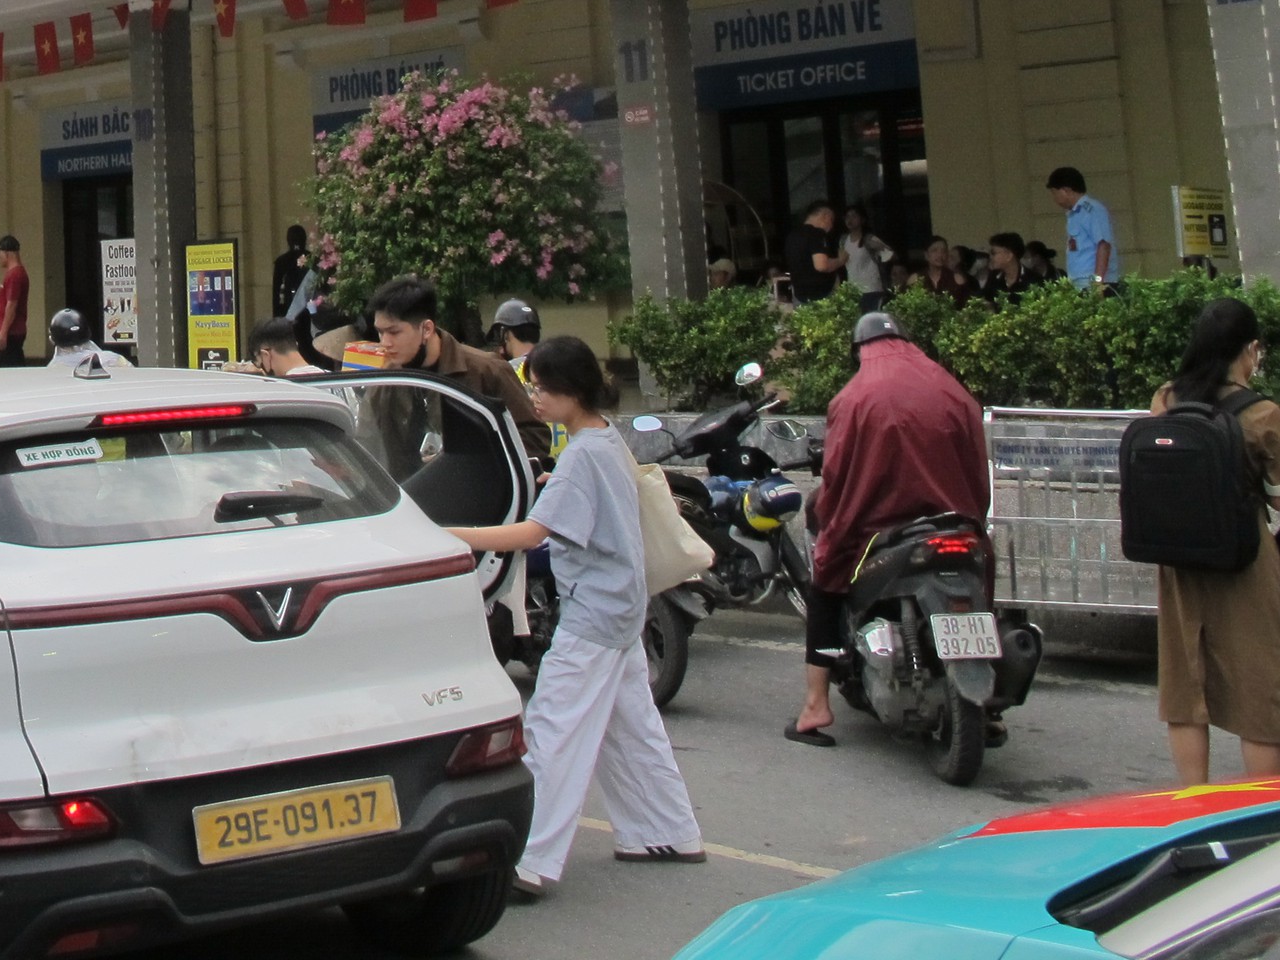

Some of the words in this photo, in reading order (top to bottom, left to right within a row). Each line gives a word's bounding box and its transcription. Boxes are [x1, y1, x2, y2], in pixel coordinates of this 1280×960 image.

[713, 8, 791, 52] PHÒNG
[619, 40, 648, 82] 11
[737, 69, 795, 94] TICKET
[800, 61, 866, 86] OFFICE
[329, 67, 383, 103] PHÒNG
[62, 112, 99, 140] SẢNH
[102, 106, 130, 135] BẮC
[58, 154, 109, 173] NORTHERN
[108, 245, 134, 259] Coffee
[24, 452, 40, 461] XE
[41, 449, 62, 460] HỢP
[65, 446, 96, 458] ĐỒNG
[941, 616, 987, 635] 38-H1
[940, 637, 997, 655] 392.05
[215, 791, 378, 849] 29E-091.37
